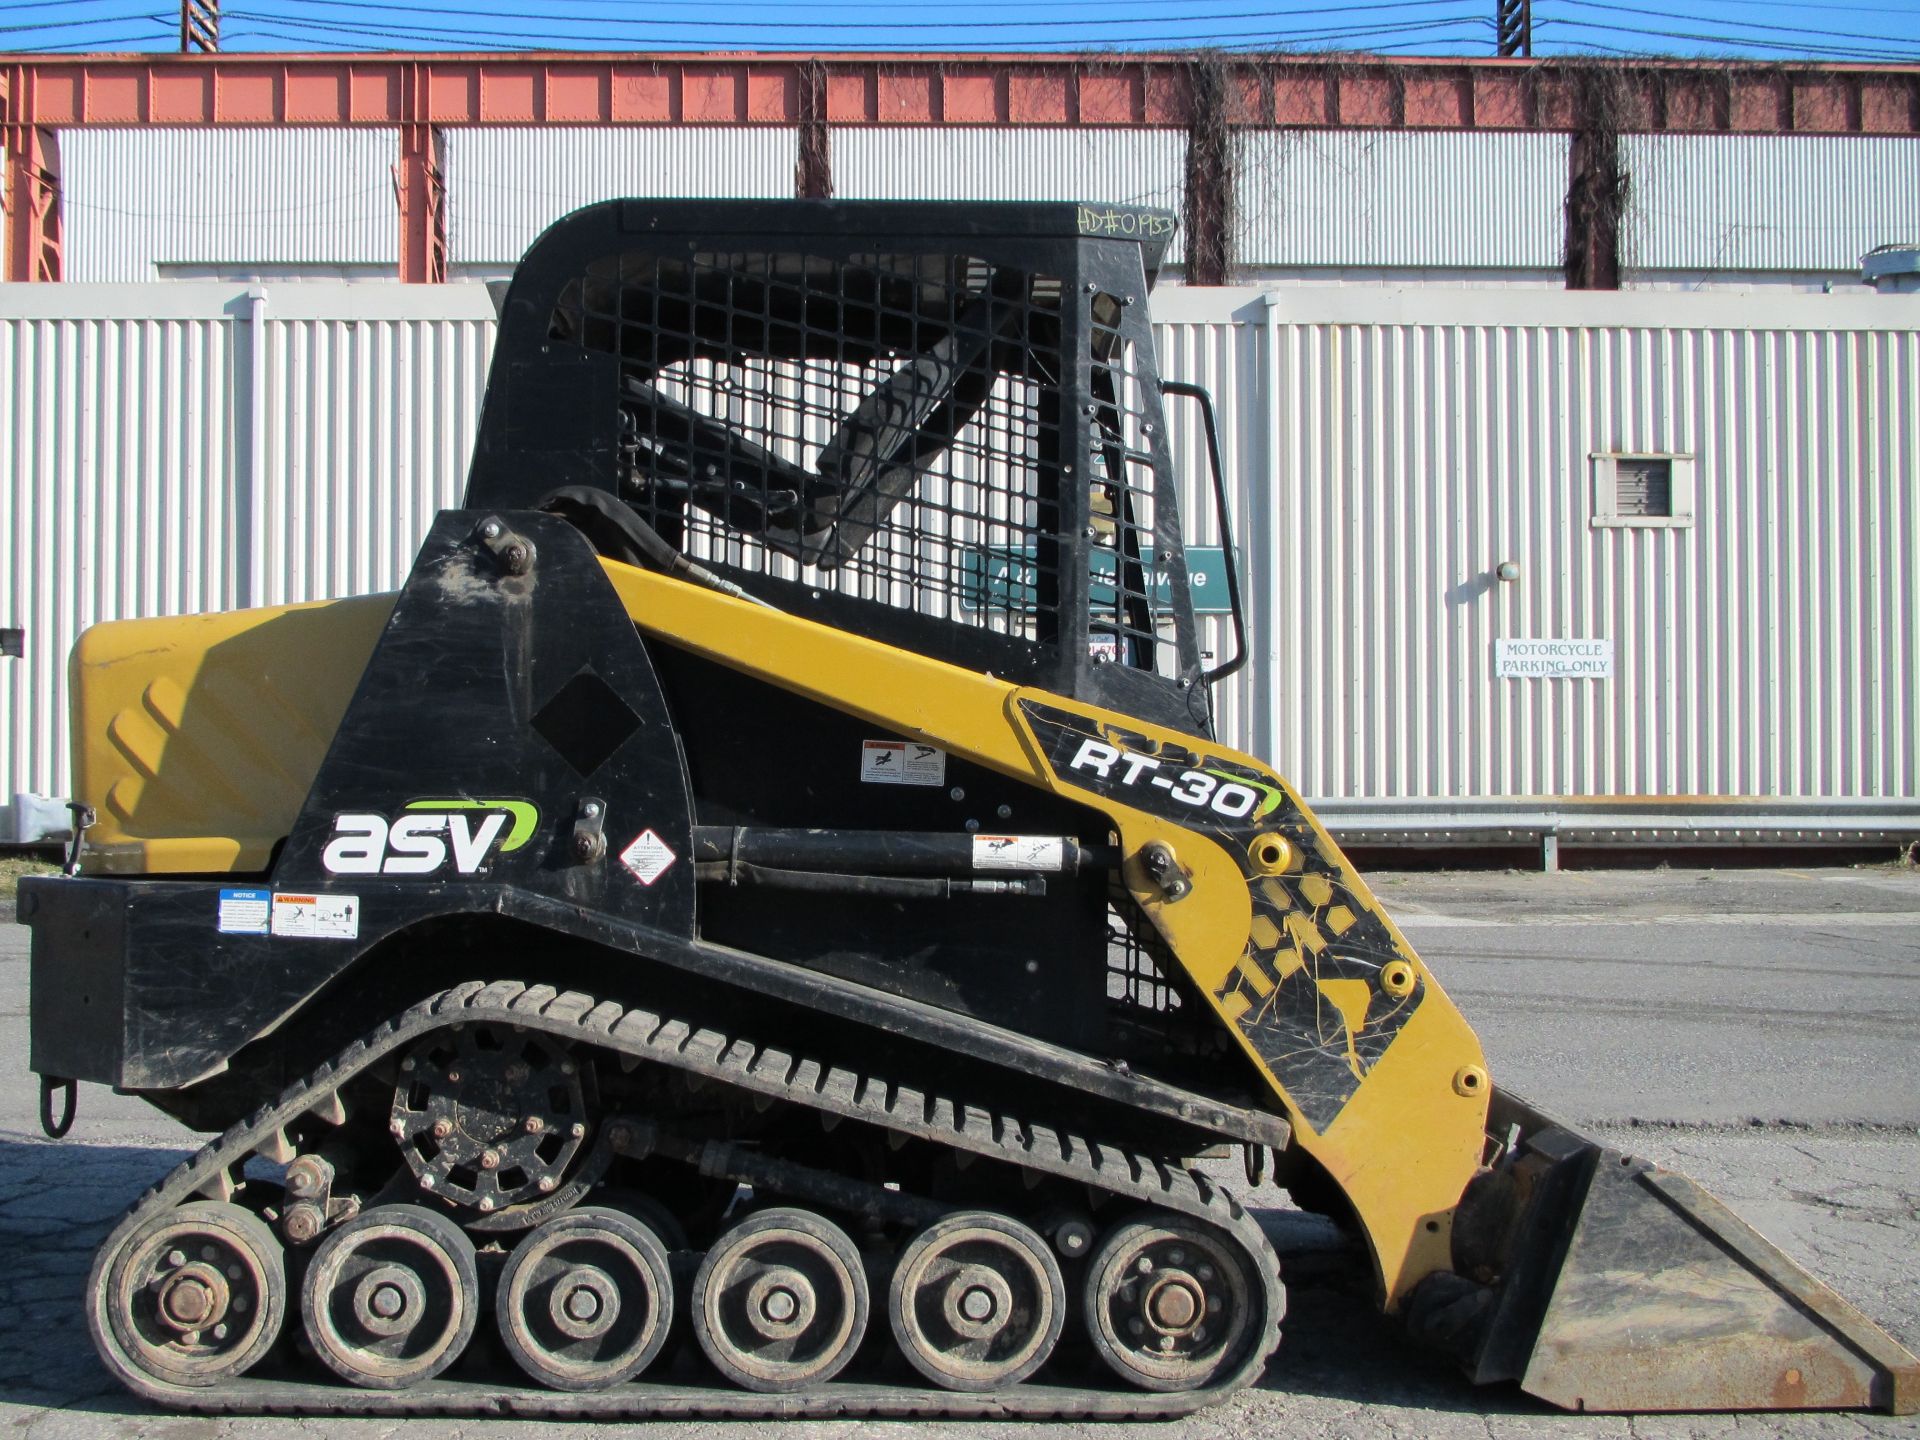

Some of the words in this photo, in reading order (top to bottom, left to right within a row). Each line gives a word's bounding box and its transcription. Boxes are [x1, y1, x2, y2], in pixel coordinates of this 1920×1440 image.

[1506, 644, 1602, 656] MOTORCYCLE
[1502, 660, 1565, 672] PARKING
[1572, 660, 1608, 672] ONLY
[1070, 738, 1256, 817] RT-30
[283, 896, 316, 904] WARNING
